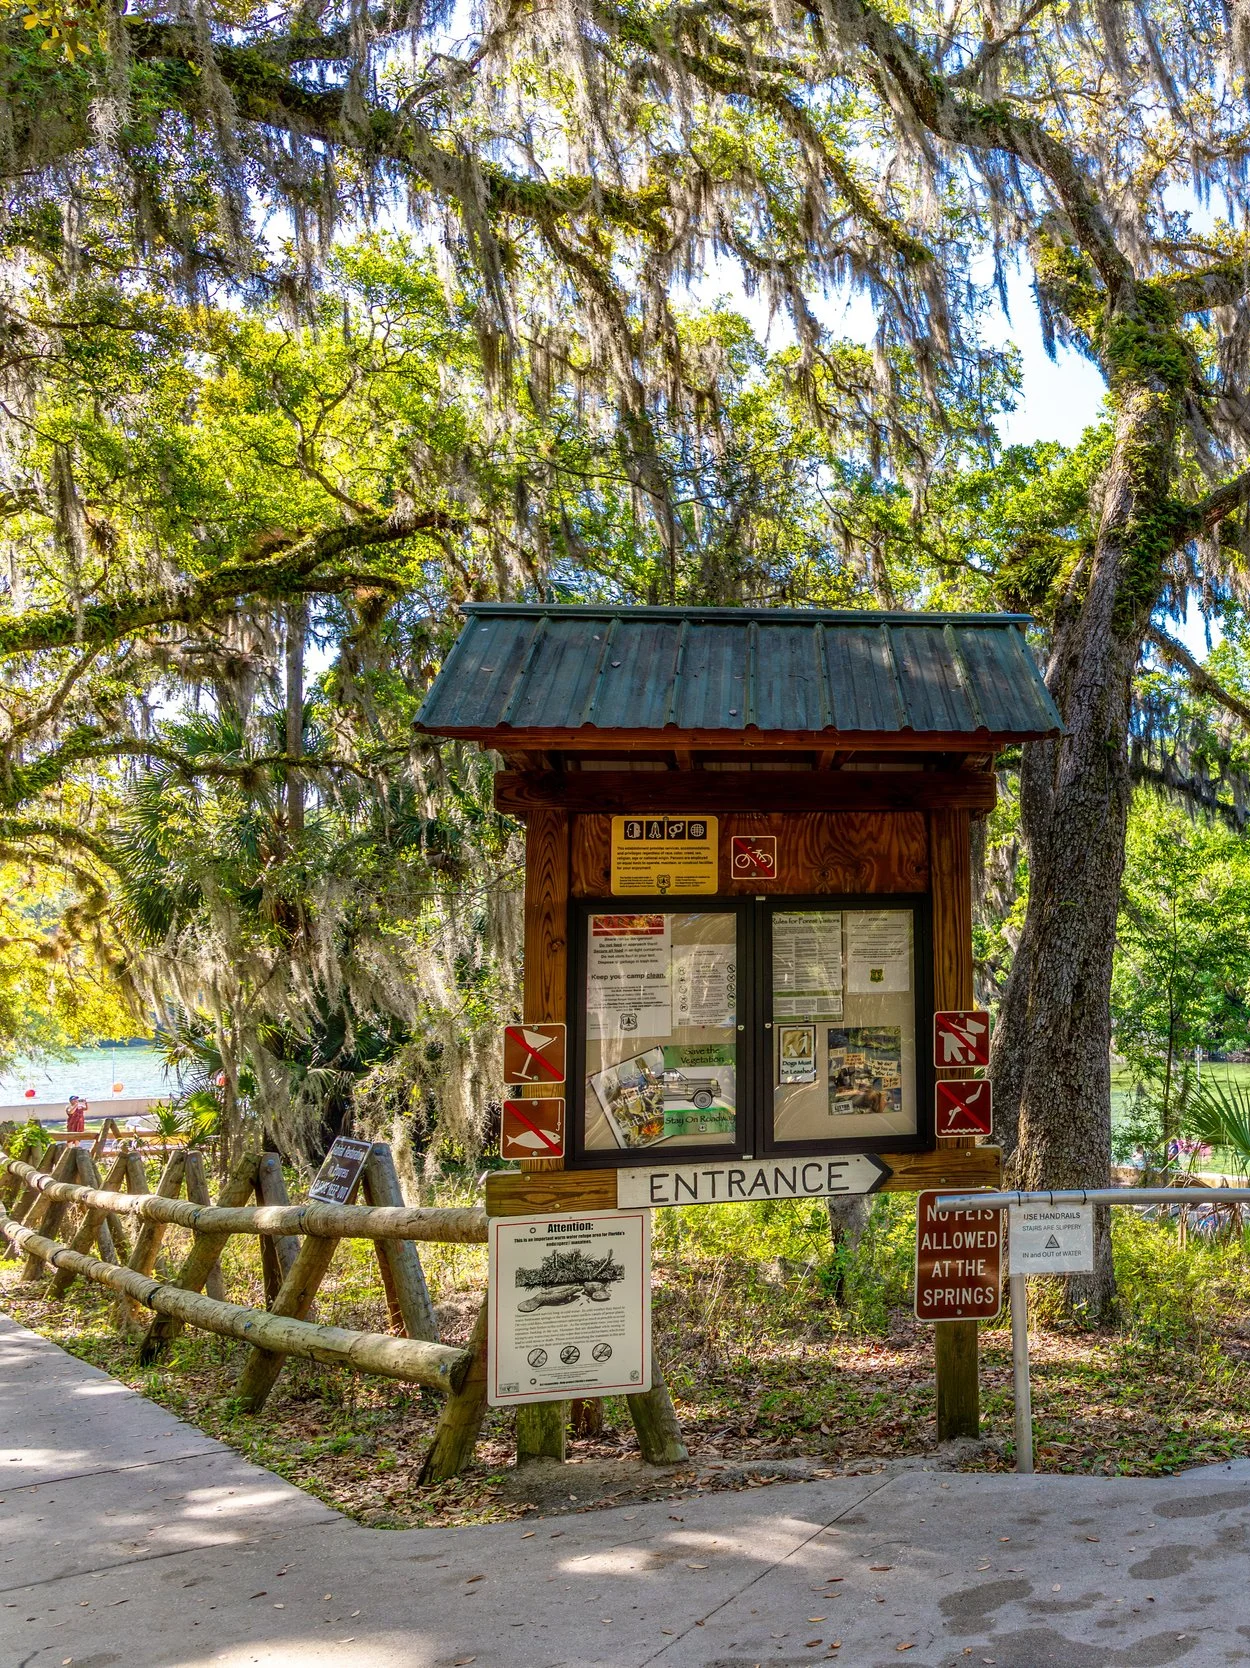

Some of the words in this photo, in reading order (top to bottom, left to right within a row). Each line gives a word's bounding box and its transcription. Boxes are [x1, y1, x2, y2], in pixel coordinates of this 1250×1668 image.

[646, 972, 666, 980] clean.
[685, 1047, 705, 1055] Save
[706, 1045, 720, 1054] the
[680, 1055, 725, 1065] Vegetation
[790, 1067, 814, 1075] Leashed
[664, 1116, 684, 1127] Stay
[685, 1115, 698, 1124] On
[650, 1161, 850, 1203] ENTRANCE
[926, 1205, 949, 1222] NO
[1040, 1211, 1081, 1220] HANDRAILS
[547, 1221, 594, 1234] Attention:
[533, 1235, 554, 1243] important
[921, 1231, 998, 1250] ALLOWED
[931, 1260, 952, 1278] AT
[955, 1259, 987, 1277] THE
[922, 1287, 995, 1307] SPRINGS
